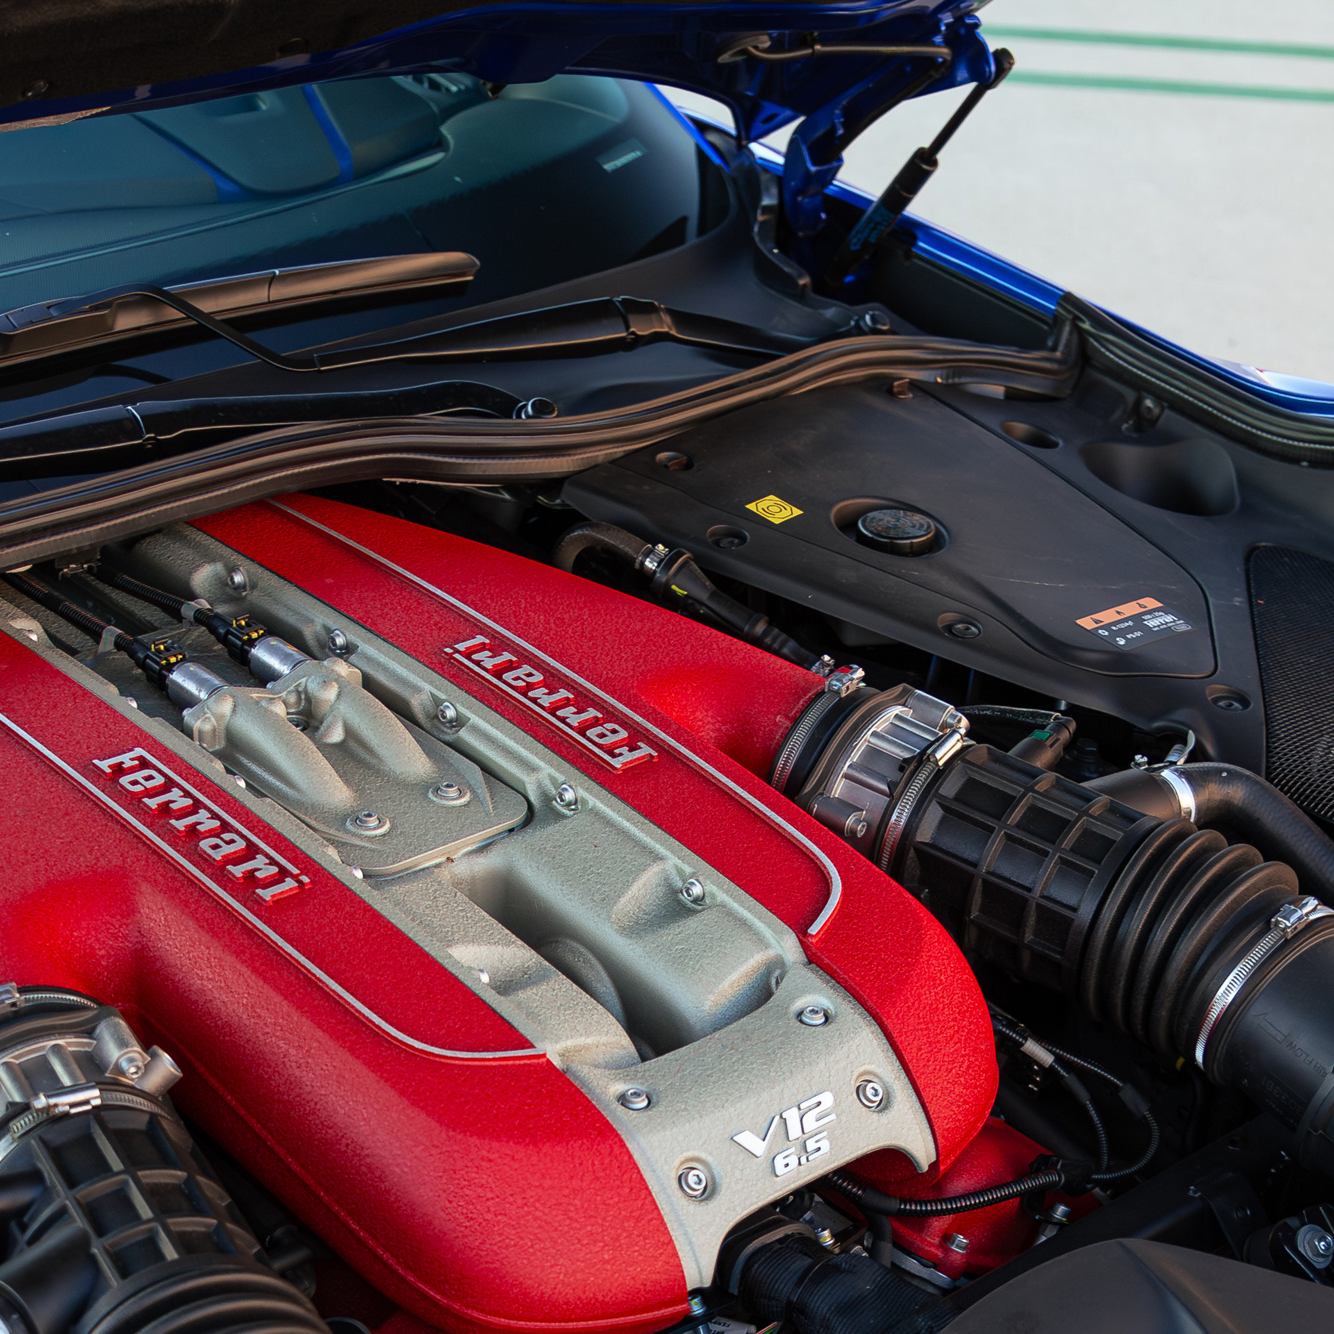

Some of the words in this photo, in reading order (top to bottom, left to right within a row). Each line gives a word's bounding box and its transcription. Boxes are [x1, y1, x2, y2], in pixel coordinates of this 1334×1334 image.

[443, 635, 658, 774] Ferrari
[92, 747, 312, 906] Ferrari
[1286, 1041, 1313, 1065] FLOW
[732, 1091, 837, 1158] V12
[773, 1131, 831, 1177] 6.5
